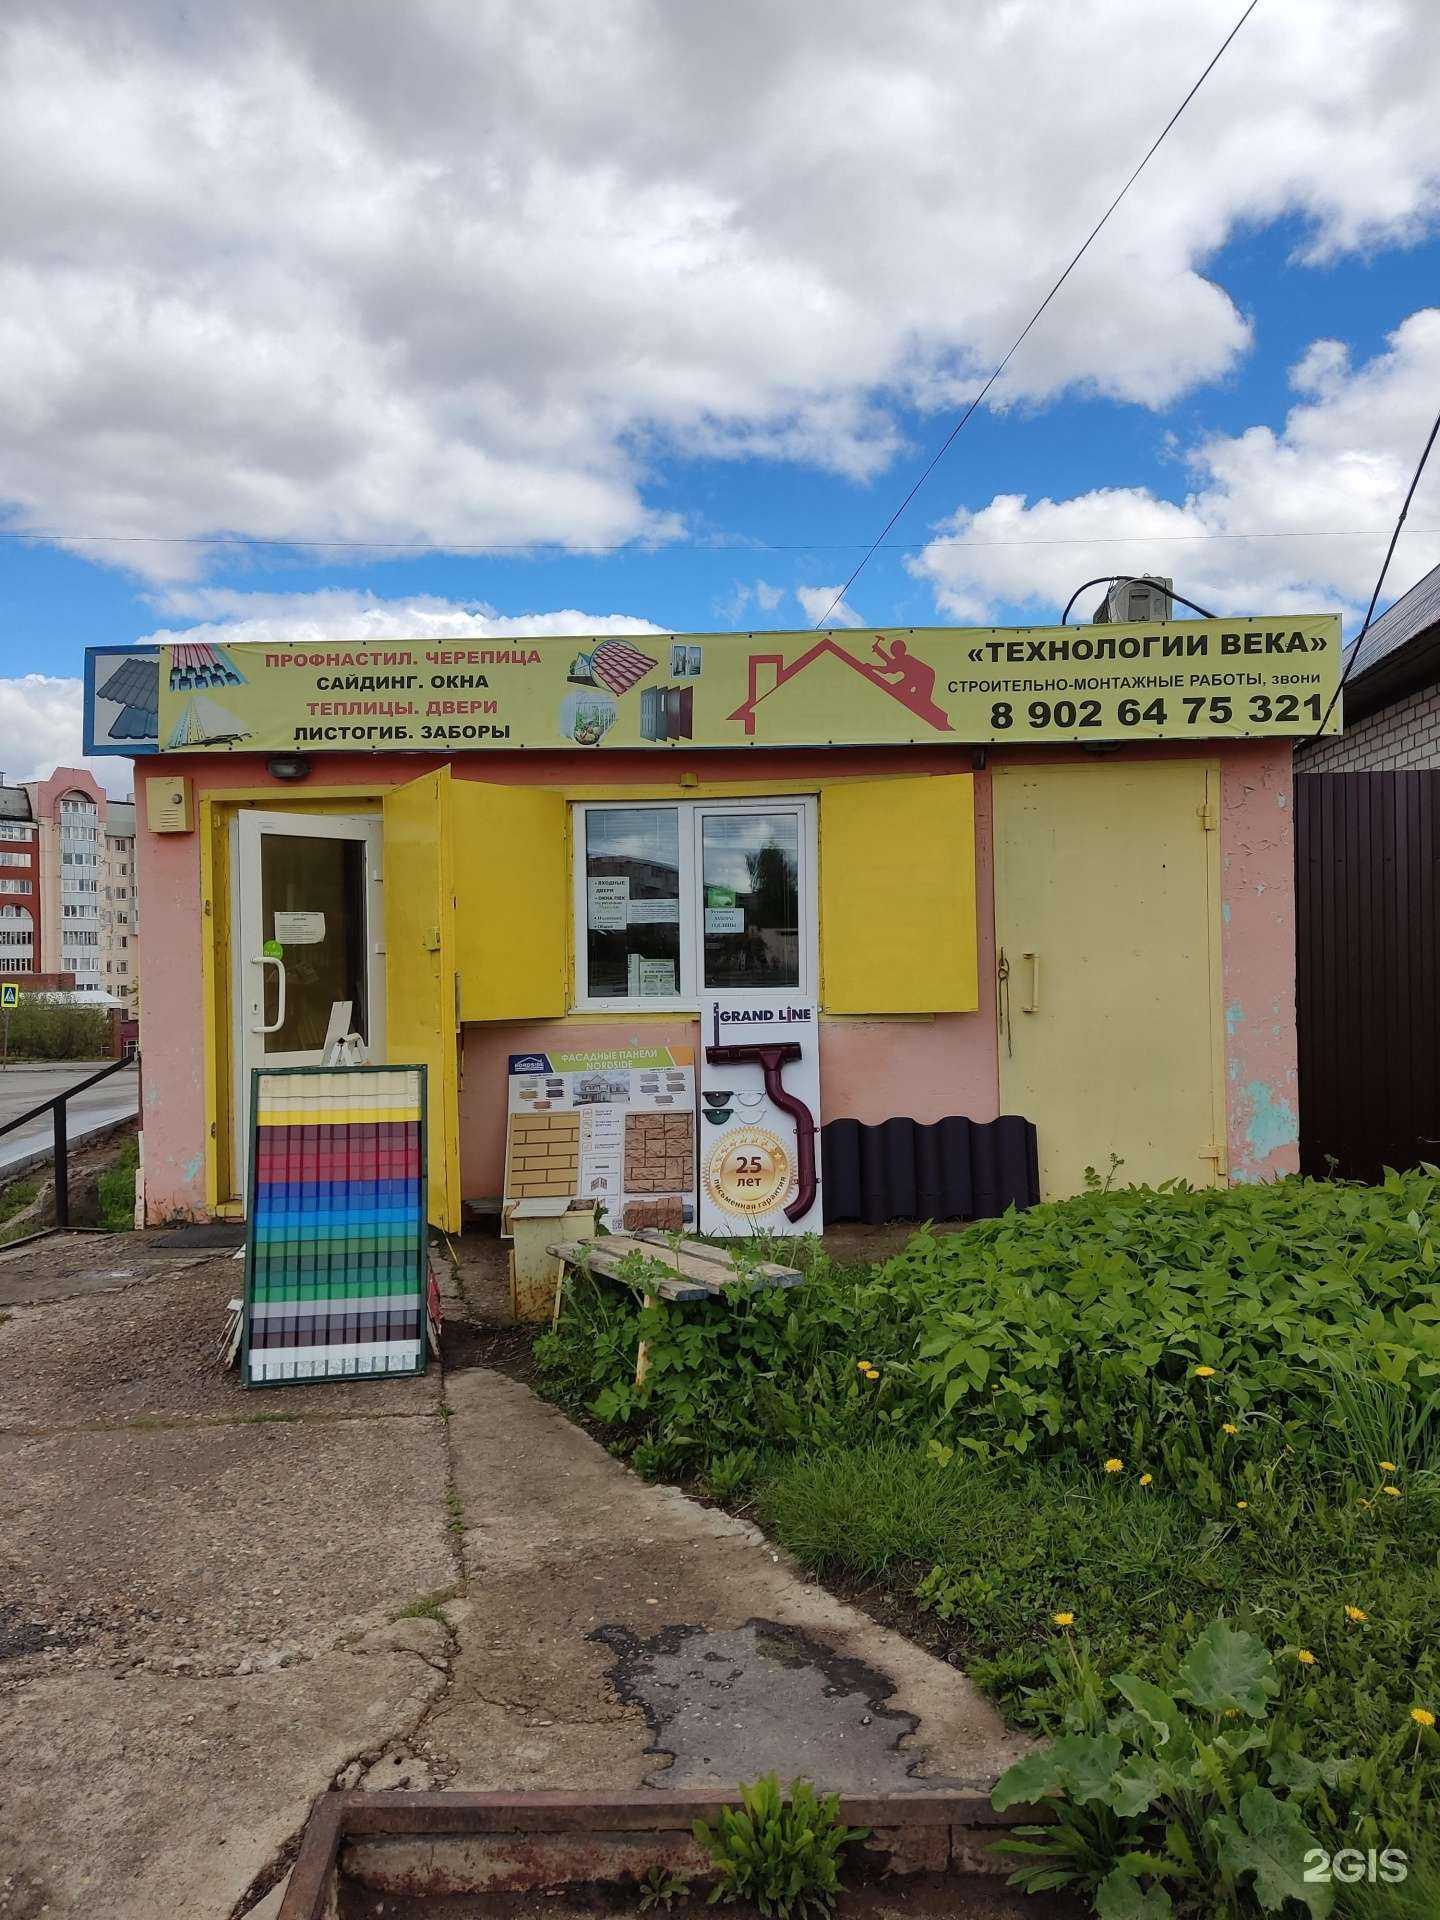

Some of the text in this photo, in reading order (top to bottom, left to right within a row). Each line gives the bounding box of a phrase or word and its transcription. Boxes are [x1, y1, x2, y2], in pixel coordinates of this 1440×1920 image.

[967, 631, 1328, 663] «ТЕХНОЛОГИИ ВЕКА»
[265, 650, 541, 668] ПРОФНАСТИЛ. ЧЕРЕПИЦА
[316, 673, 489, 692] САЙДИНГ. ОКНА
[948, 673, 1321, 693] СТРОИТЕЛЬНО-МОНТАЖНЫЕ РАБОТЫ, звони
[306, 700, 498, 718] ТЕПЛИЦЫ. ДВЕРИ
[990, 694, 1321, 729] 8 902 64 75 321
[293, 725, 510, 741] ЛИСТОГИБ. ЗАБОРЫ
[720, 1006, 811, 1023] GRAND LINE
[561, 1048, 658, 1063] ФАСАДНЫЕ ПАНЕЛИ
[586, 1060, 633, 1070] NORDSIDE
[735, 1156, 762, 1173] 25
[736, 1176, 762, 1187] лет
[714, 1176, 786, 1210] письменная гарантия
